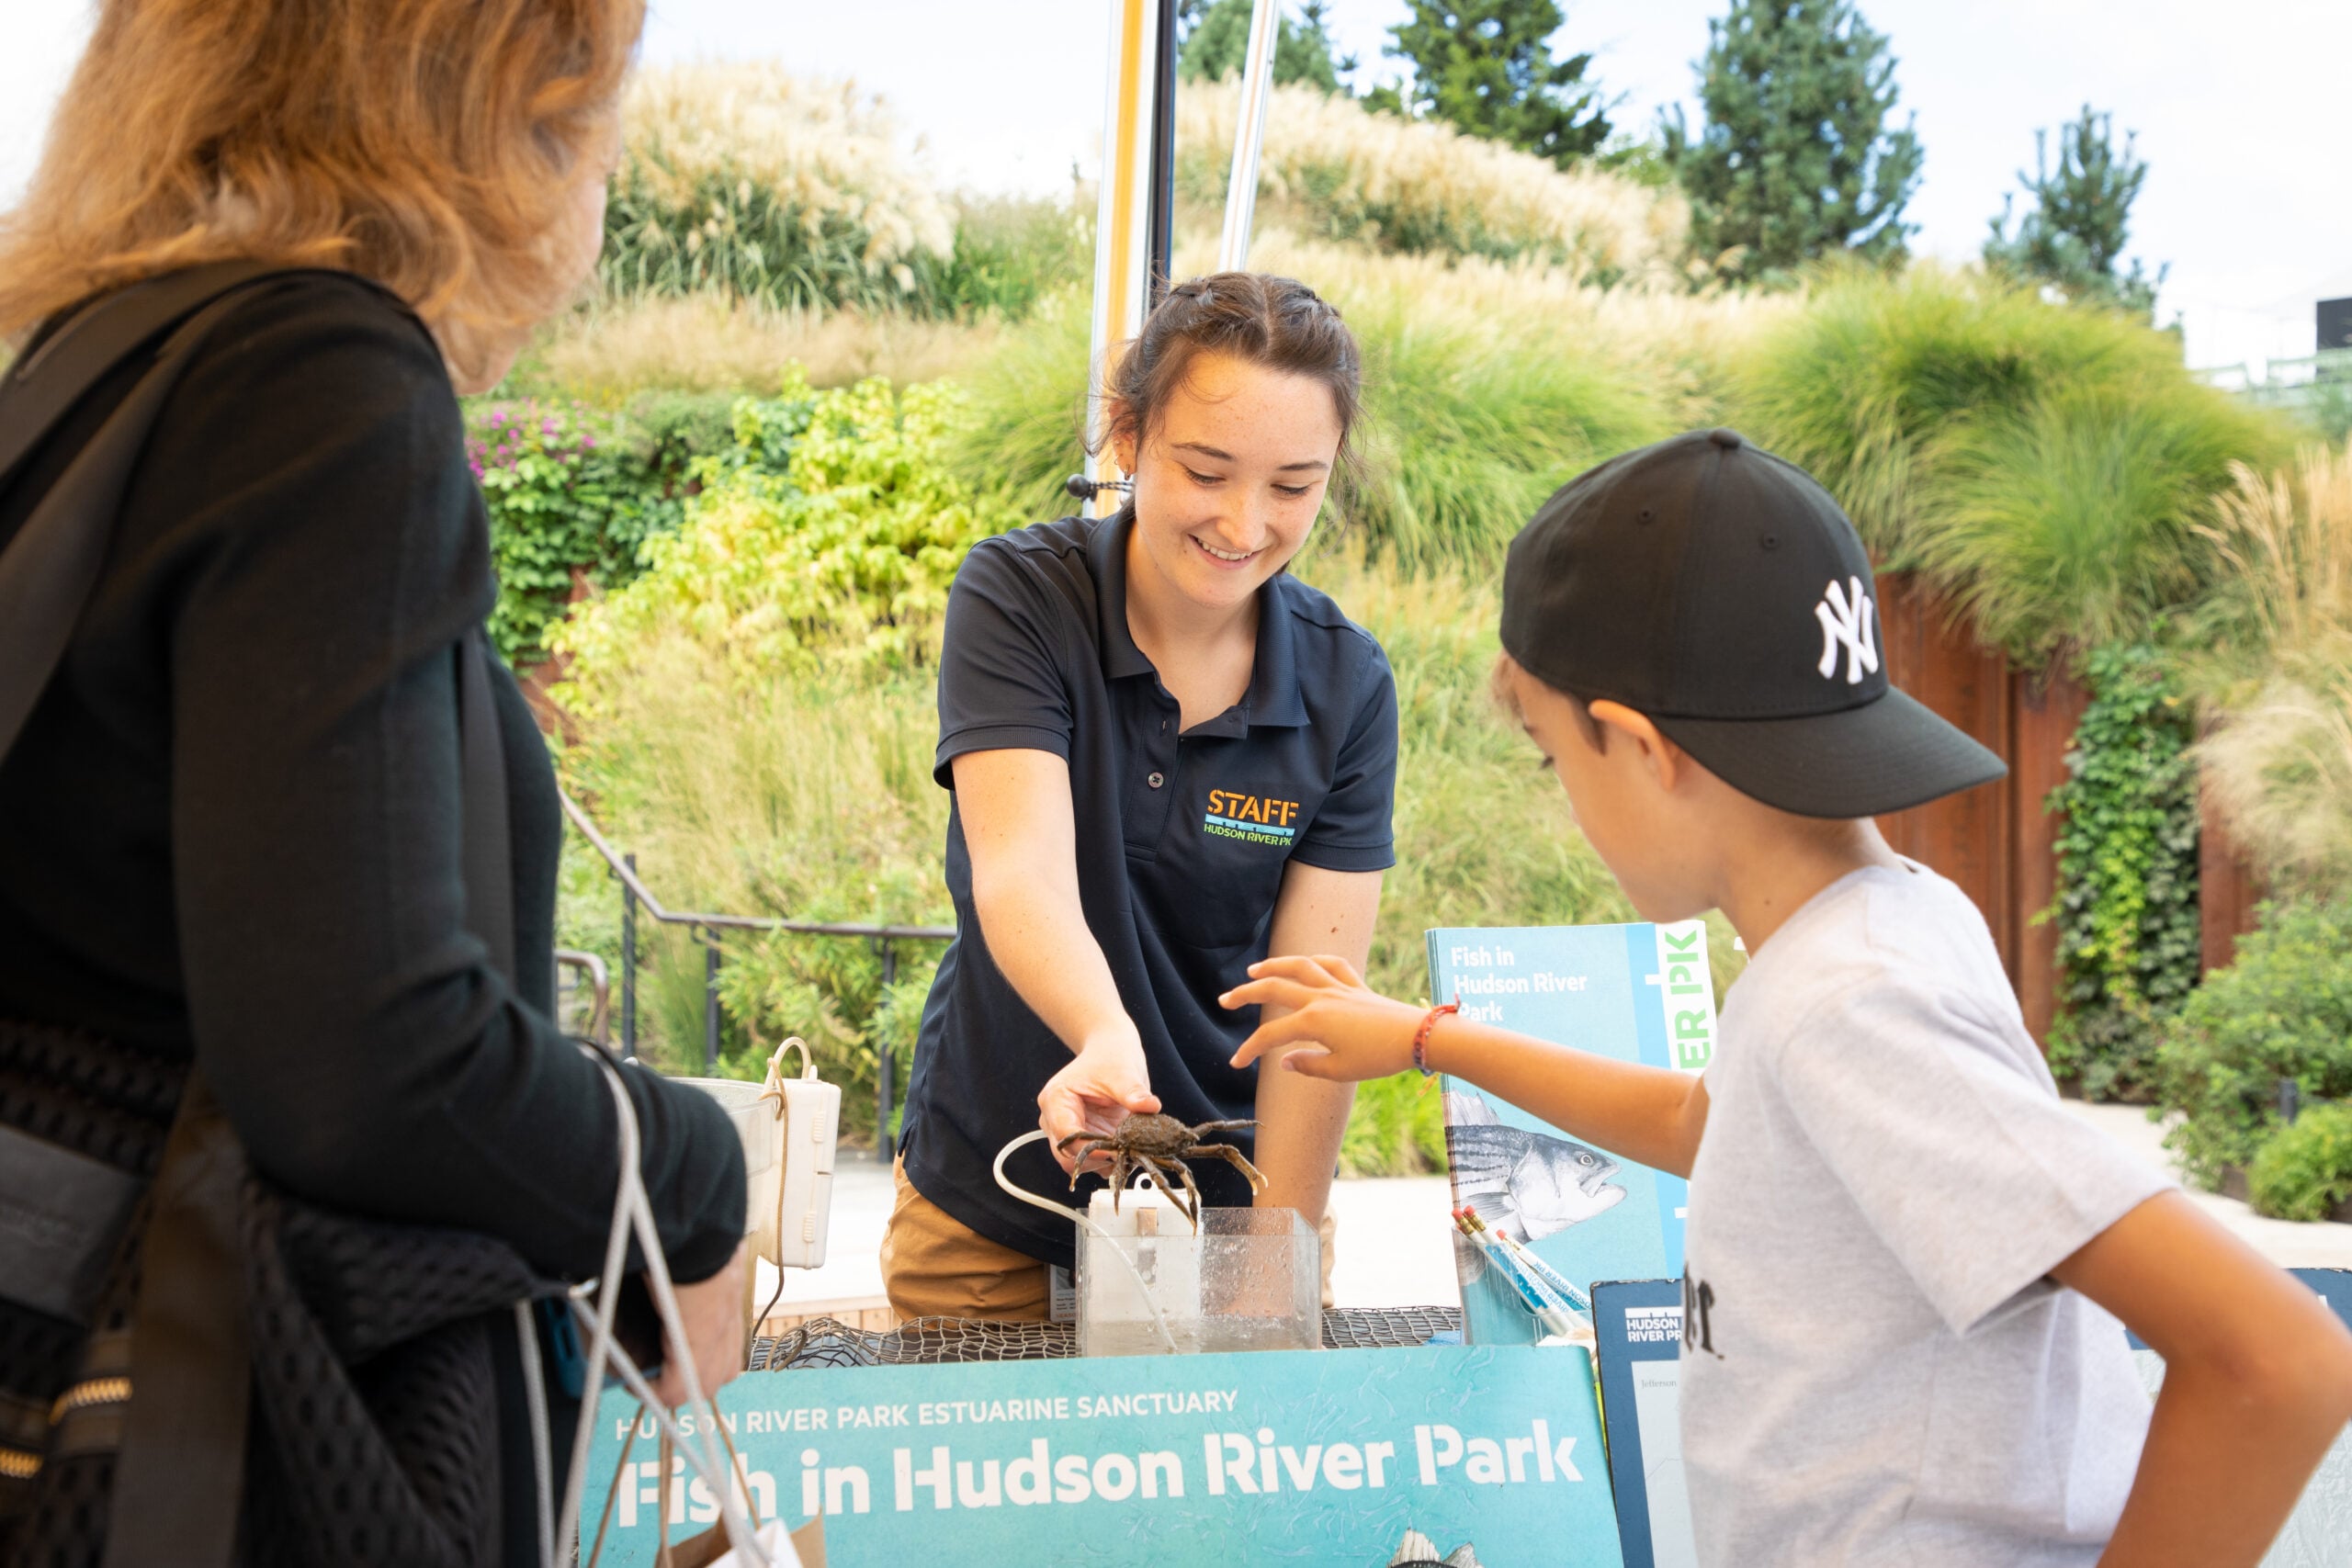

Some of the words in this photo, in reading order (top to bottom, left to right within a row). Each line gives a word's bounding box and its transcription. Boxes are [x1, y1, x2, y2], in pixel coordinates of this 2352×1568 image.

[1814, 575, 1879, 684] NY
[1207, 789, 1299, 826] STAFF
[1204, 823, 1246, 841] HUDSON
[1247, 831, 1278, 846] RIVER
[1279, 837, 1293, 846] PK
[1451, 946, 1493, 966] Fish
[1496, 946, 1515, 966] in
[1665, 930, 1703, 995] PK
[1453, 973, 1530, 995] Hudson
[1532, 972, 1588, 993] River
[1546, 1270, 1569, 1292] RIVER
[1626, 1318, 1679, 1330] HUDSON
[1628, 1330, 1665, 1342] RIVER
[1666, 1330, 1681, 1341] PR
[616, 1412, 737, 1441] HUSON
[746, 1408, 828, 1434] RIVER
[837, 1404, 910, 1429] PARK
[919, 1397, 1070, 1426] ESTUARINE
[1077, 1390, 1238, 1418] SANCTUARY
[619, 1452, 776, 1528] Fish
[801, 1449, 870, 1516] in
[894, 1438, 1184, 1512] Hudson
[1204, 1427, 1395, 1495] River
[1413, 1419, 1584, 1486] Park
